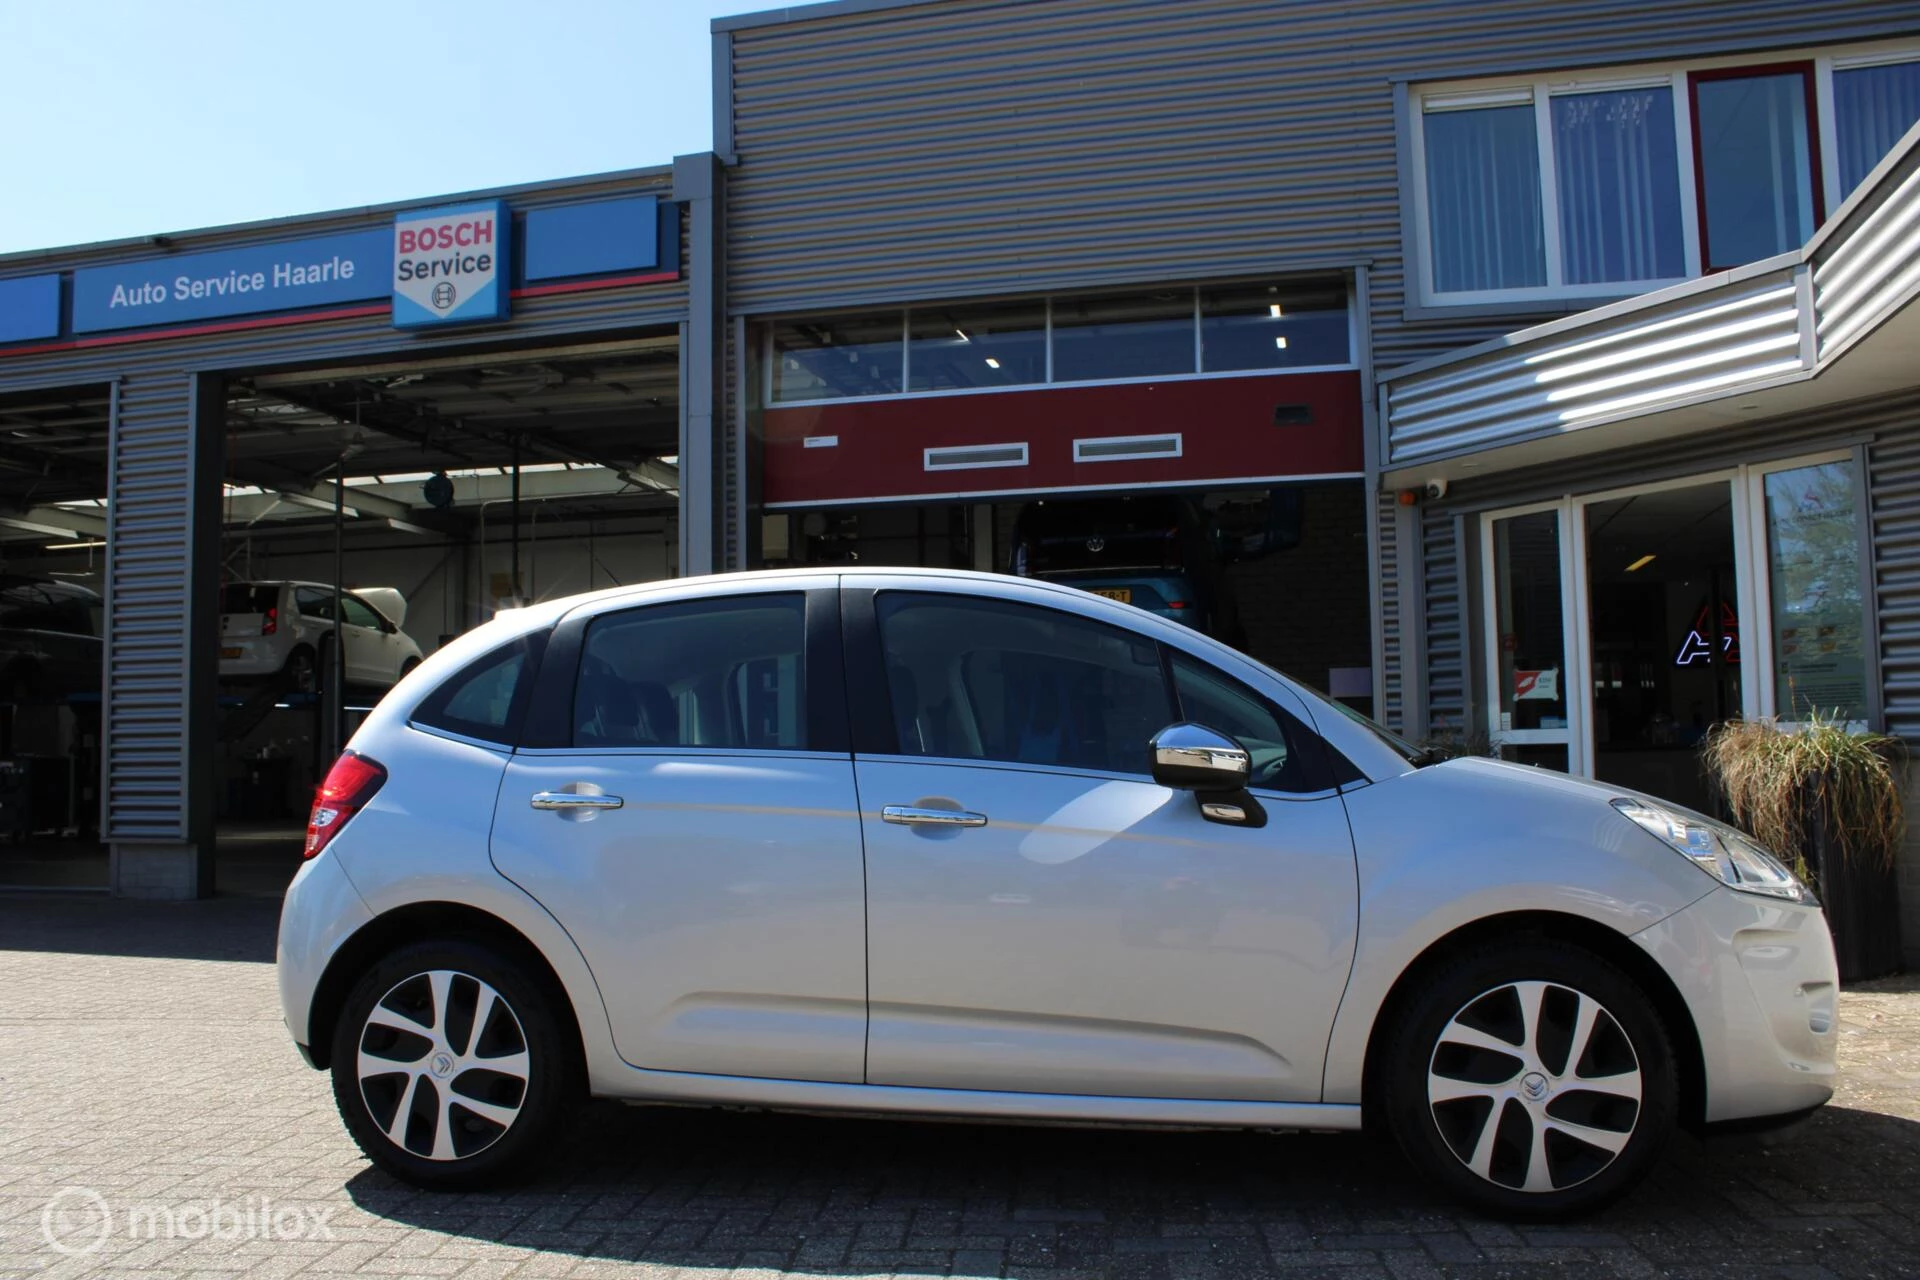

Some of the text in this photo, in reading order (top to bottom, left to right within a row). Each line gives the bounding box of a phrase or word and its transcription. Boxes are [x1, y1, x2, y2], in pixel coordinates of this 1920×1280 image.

[399, 219, 493, 254] BOSCH
[110, 256, 355, 308] Auto Service Haarle
[398, 252, 491, 281] Service
